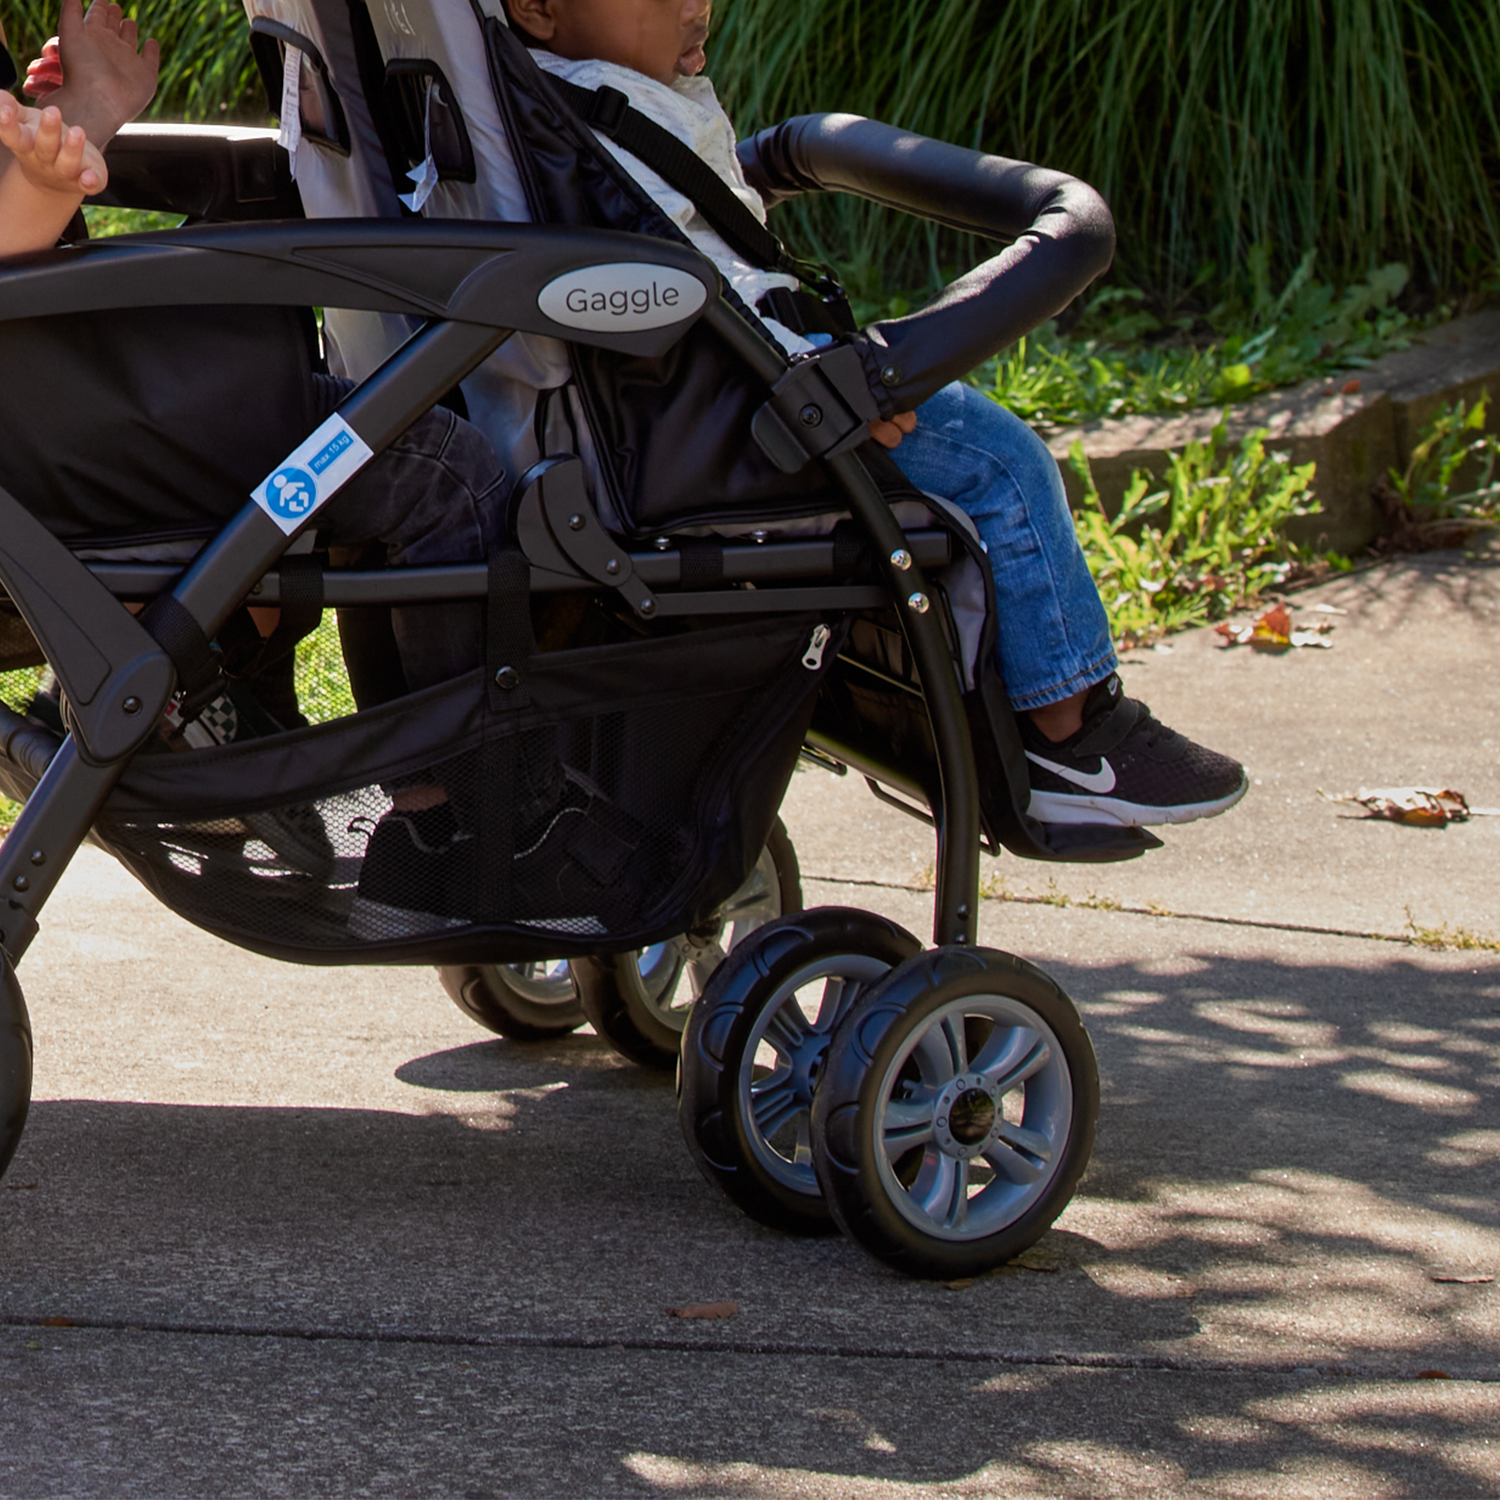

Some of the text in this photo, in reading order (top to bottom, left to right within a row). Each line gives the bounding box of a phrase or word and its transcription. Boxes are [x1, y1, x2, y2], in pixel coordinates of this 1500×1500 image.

[565, 281, 680, 316] Gaggle
[314, 435, 350, 470] max 15 kg
